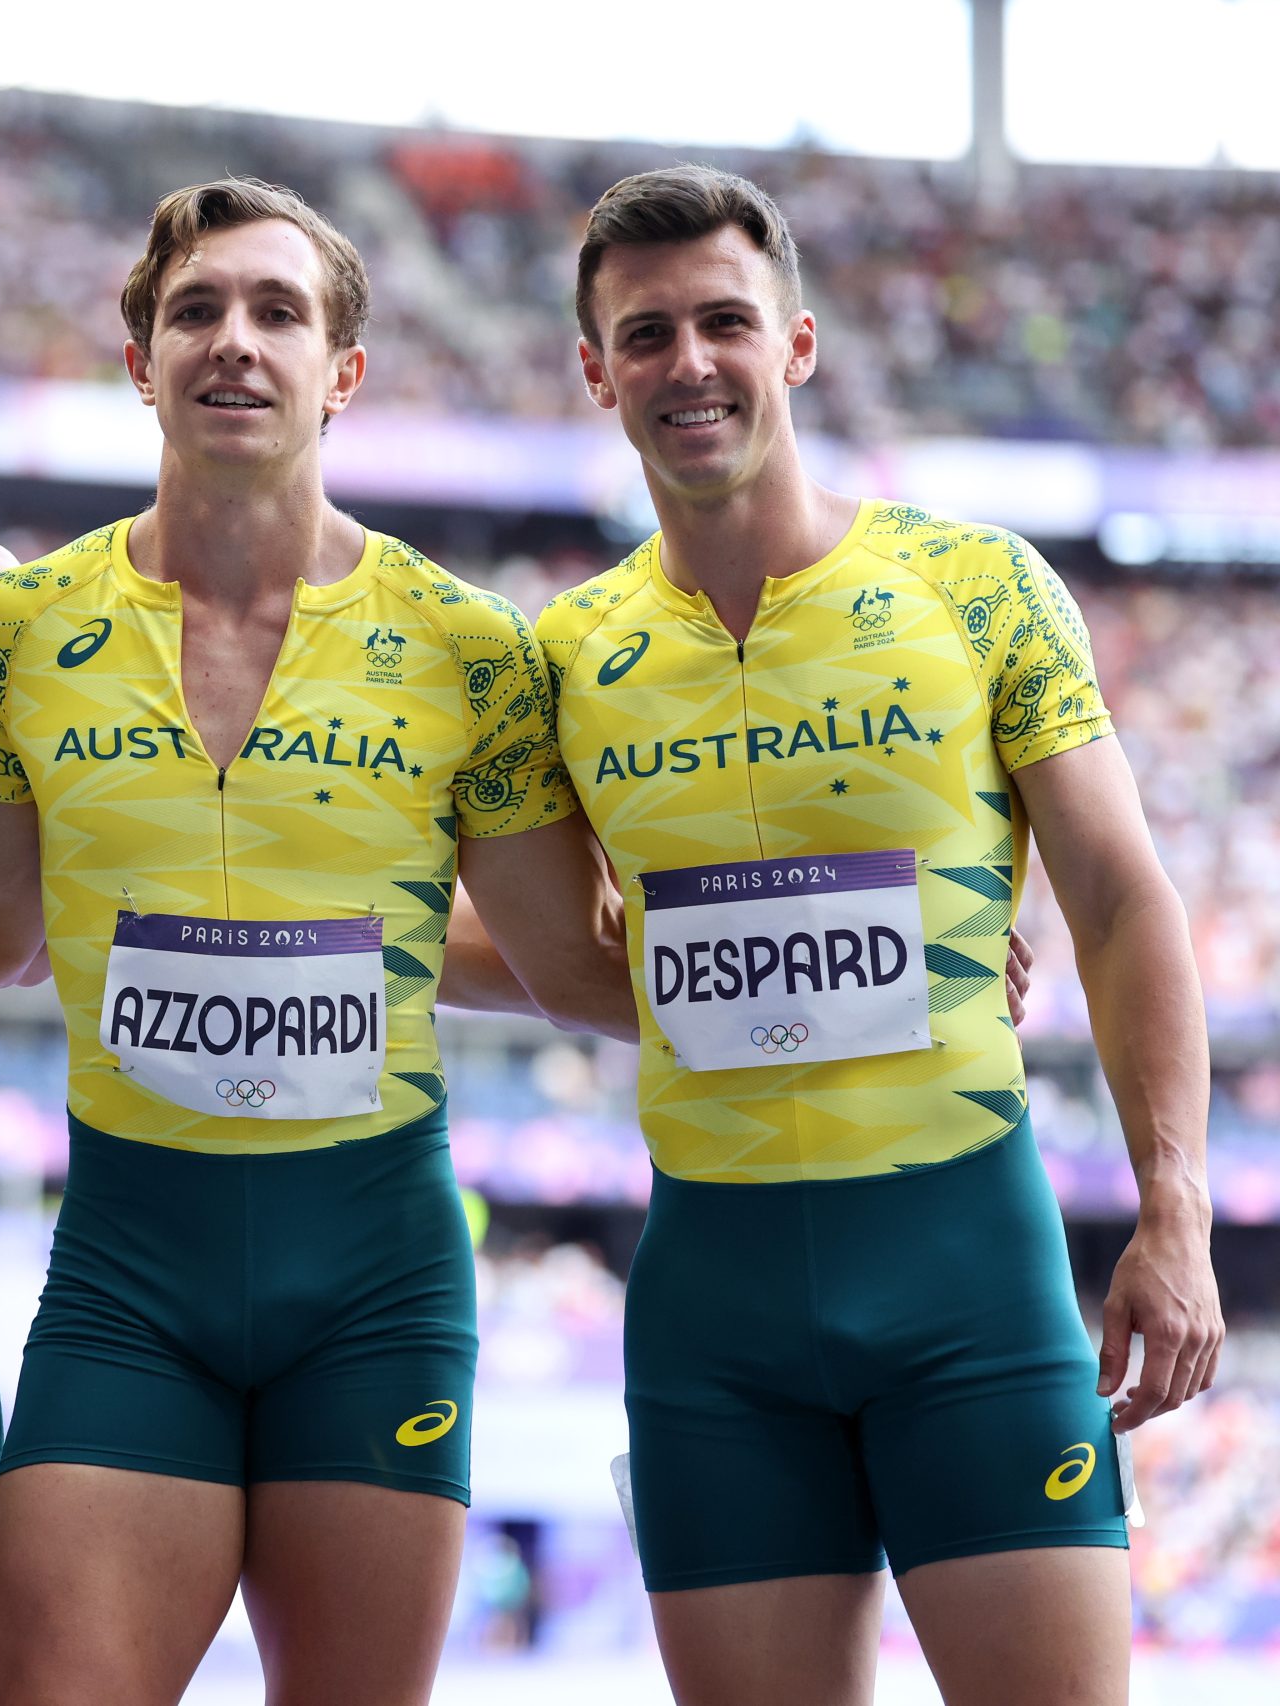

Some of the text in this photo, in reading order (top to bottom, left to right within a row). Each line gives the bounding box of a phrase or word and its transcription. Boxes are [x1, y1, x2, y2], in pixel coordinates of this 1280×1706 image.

[853, 630, 895, 643] AUSTRALIA
[854, 637, 895, 650] PARIS 2024
[366, 670, 402, 678] AUSTRALIA
[595, 703, 922, 784] AUSTRALIA
[773, 867, 838, 888] 2024
[259, 928, 318, 947] 2024
[653, 925, 908, 1006] DESPARD
[110, 986, 378, 1057] AZZOPARDI
